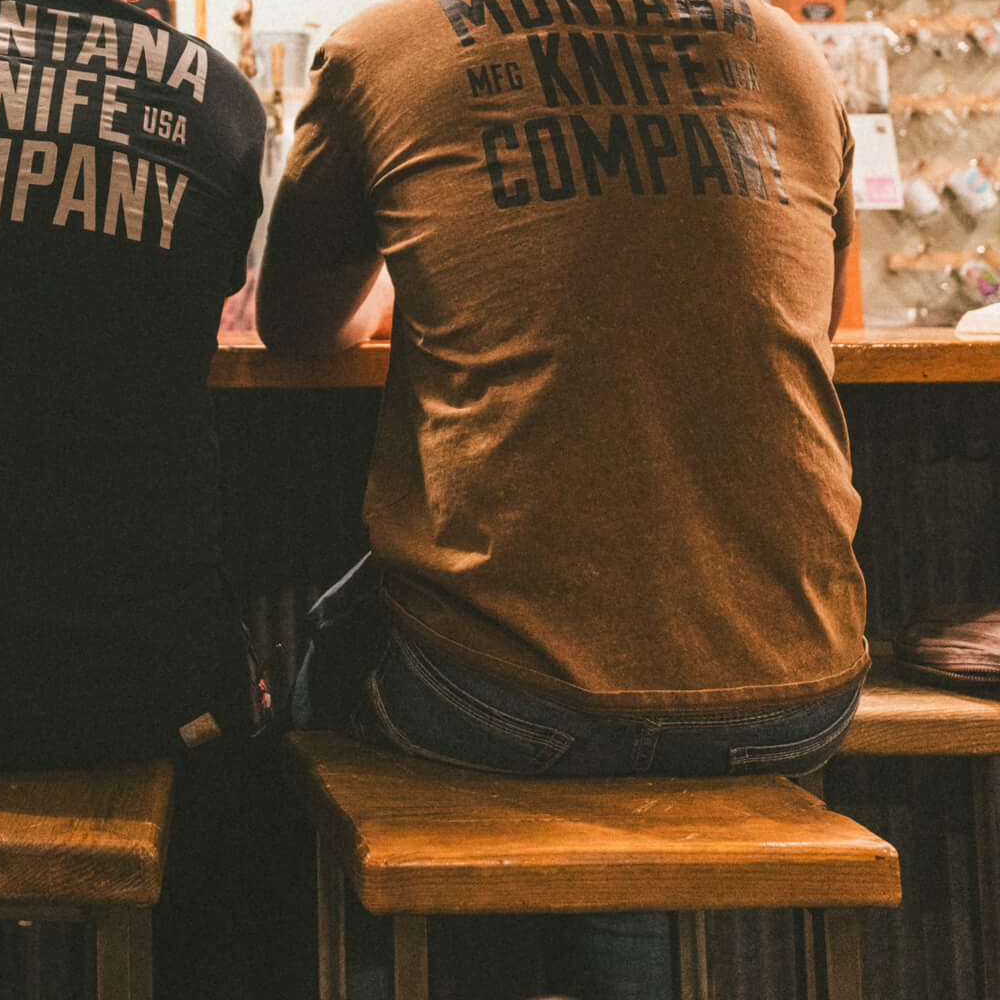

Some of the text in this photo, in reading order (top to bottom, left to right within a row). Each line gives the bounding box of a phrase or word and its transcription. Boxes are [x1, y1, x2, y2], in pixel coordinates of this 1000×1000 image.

[466, 61, 524, 98] MFG
[527, 31, 723, 108] KNIFE
[143, 105, 188, 145] USA
[480, 113, 789, 210] COMPANY
